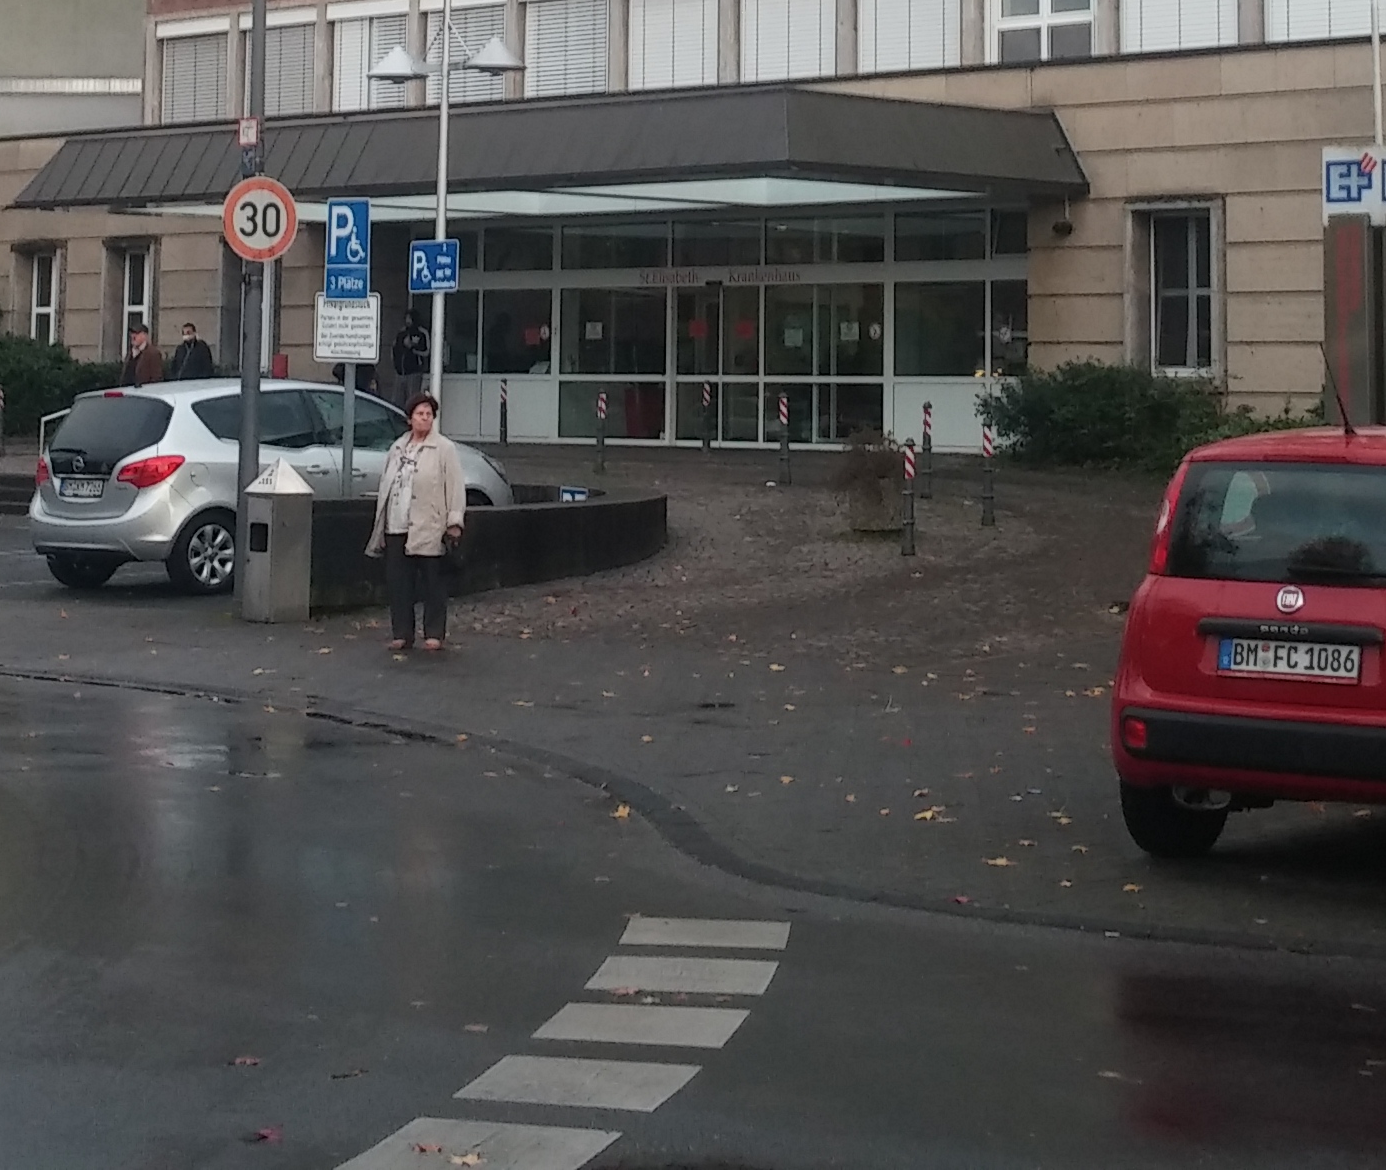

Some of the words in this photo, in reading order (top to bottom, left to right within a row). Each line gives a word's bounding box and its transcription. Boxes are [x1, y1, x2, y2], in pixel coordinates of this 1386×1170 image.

[239, 201, 281, 238] 30
[329, 205, 354, 258] P
[413, 250, 426, 280] P
[329, 276, 336, 290] 3
[338, 275, 364, 290] Plätze
[1233, 642, 1259, 667] BM
[1273, 645, 1299, 669] FC
[1304, 647, 1355, 673] 1086
